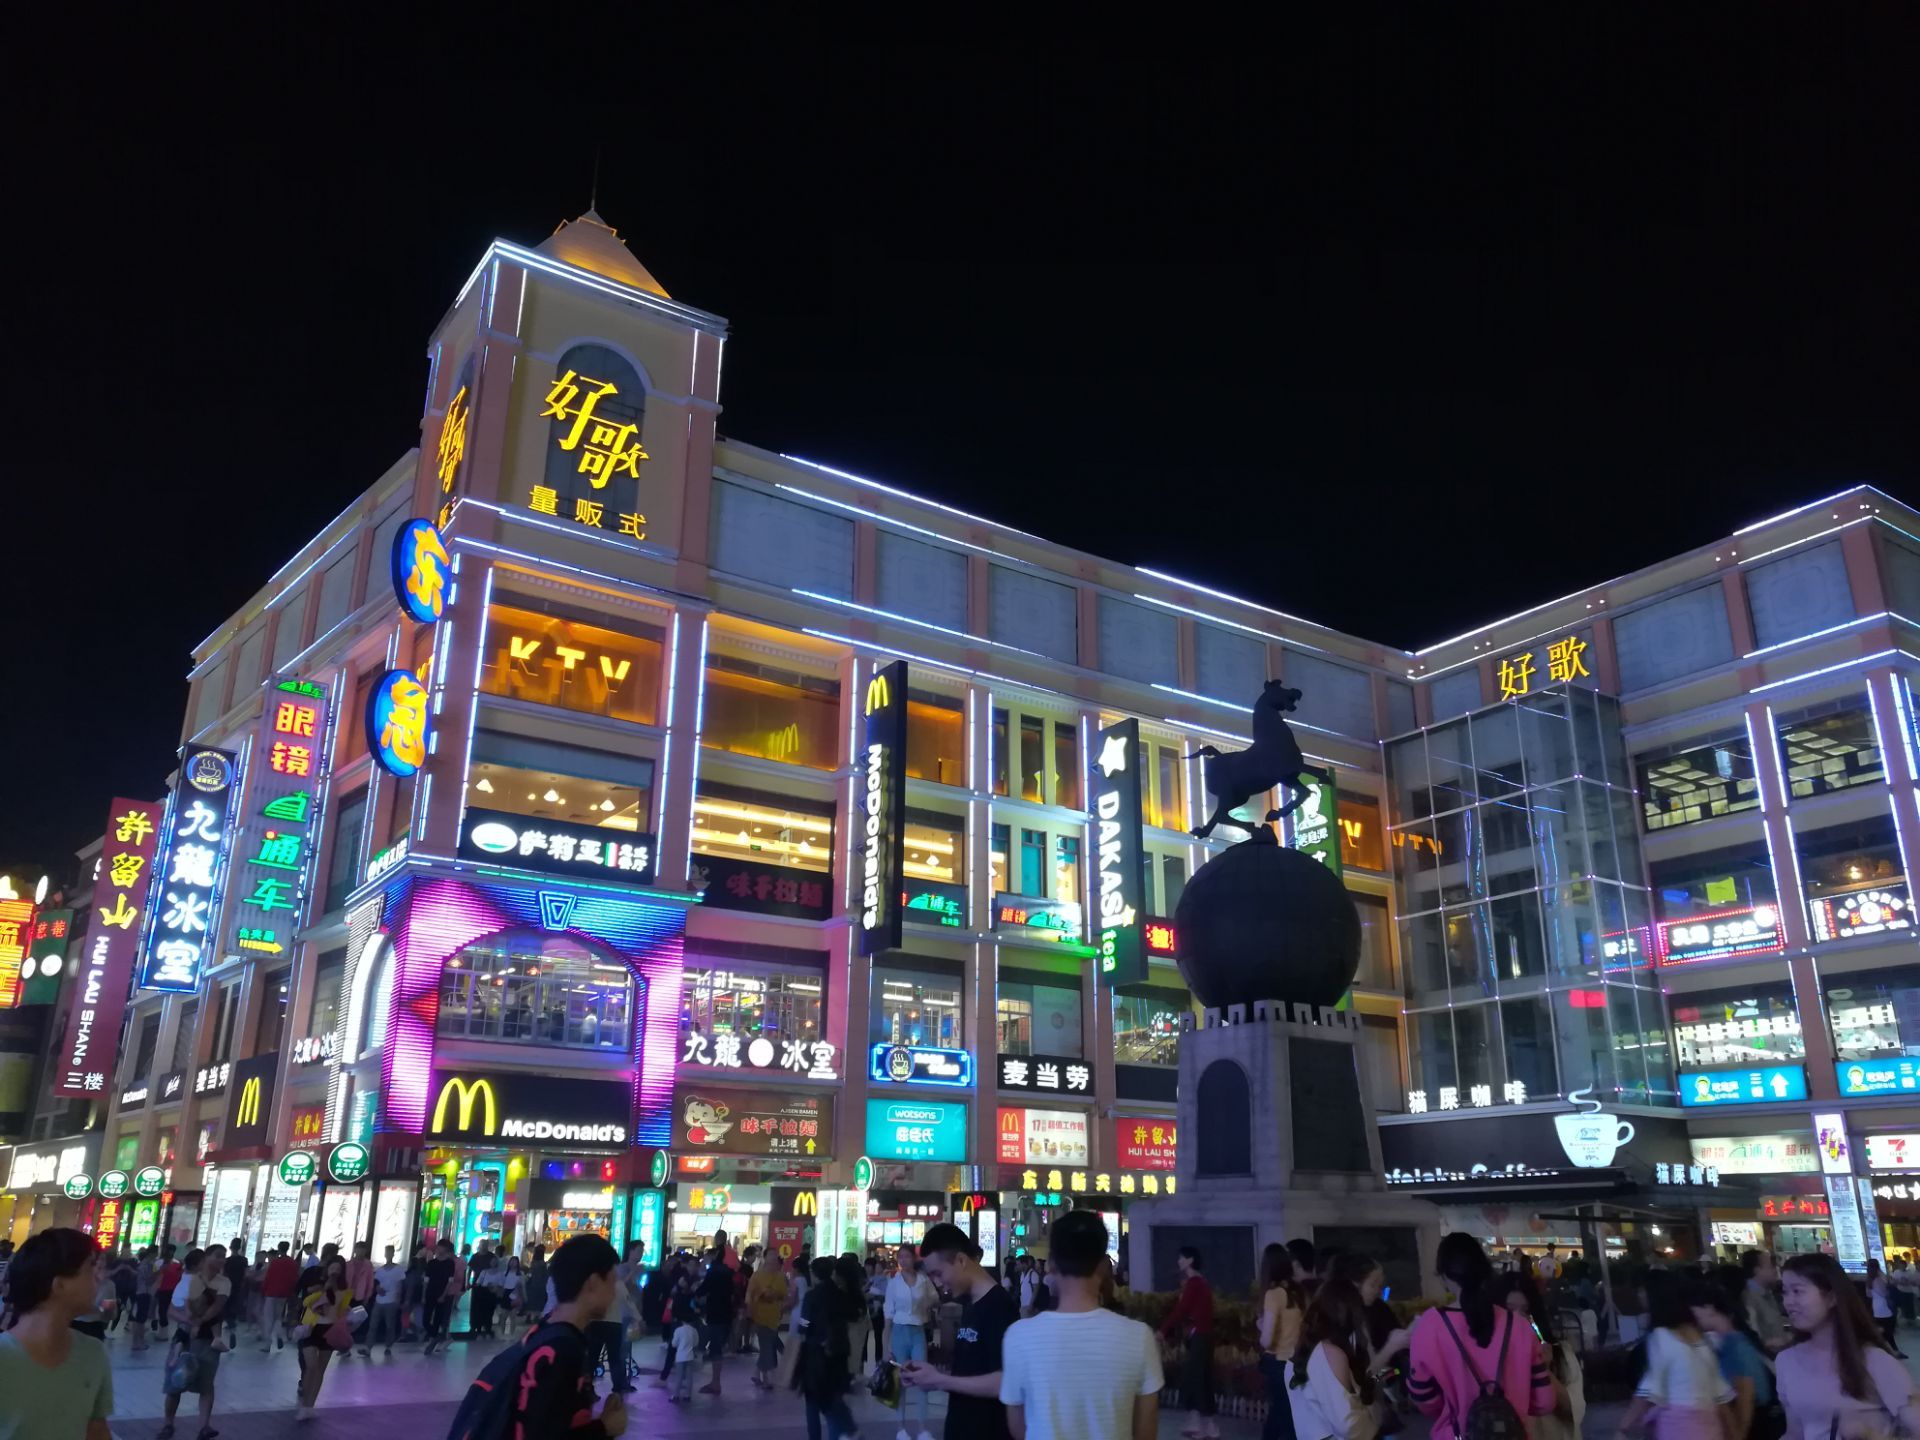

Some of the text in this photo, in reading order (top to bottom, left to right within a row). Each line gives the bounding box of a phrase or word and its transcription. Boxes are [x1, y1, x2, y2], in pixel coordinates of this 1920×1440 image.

[540, 369, 648, 489] 好歌
[528, 485, 648, 540] 量贩式
[510, 636, 630, 686] KTV
[1497, 636, 1590, 701] 好歌
[271, 702, 316, 777] 眼镜
[519, 831, 604, 864] 萨莉亚
[863, 744, 882, 930] McDonald's
[1098, 790, 1124, 928] DAKASI
[100, 810, 153, 930] 許留山
[1102, 929, 1118, 973] tea
[75, 936, 110, 1056] HUI LAU SHAN
[683, 1031, 836, 1075] 九龍 冰室
[1003, 1060, 1089, 1090] 麦当劳
[64, 1072, 103, 1091] 三楼
[195, 1062, 230, 1093] 麦当劳
[1409, 1081, 1527, 1114] 猫屎咖啡
[501, 1119, 625, 1142] McDonald's
[895, 1110, 936, 1120] watsons
[1128, 1147, 1142, 1155] HUI
[1145, 1148, 1161, 1156] LAU
[1656, 1162, 1719, 1188] 猫屎咖啡
[97, 1201, 119, 1249] 直通车
